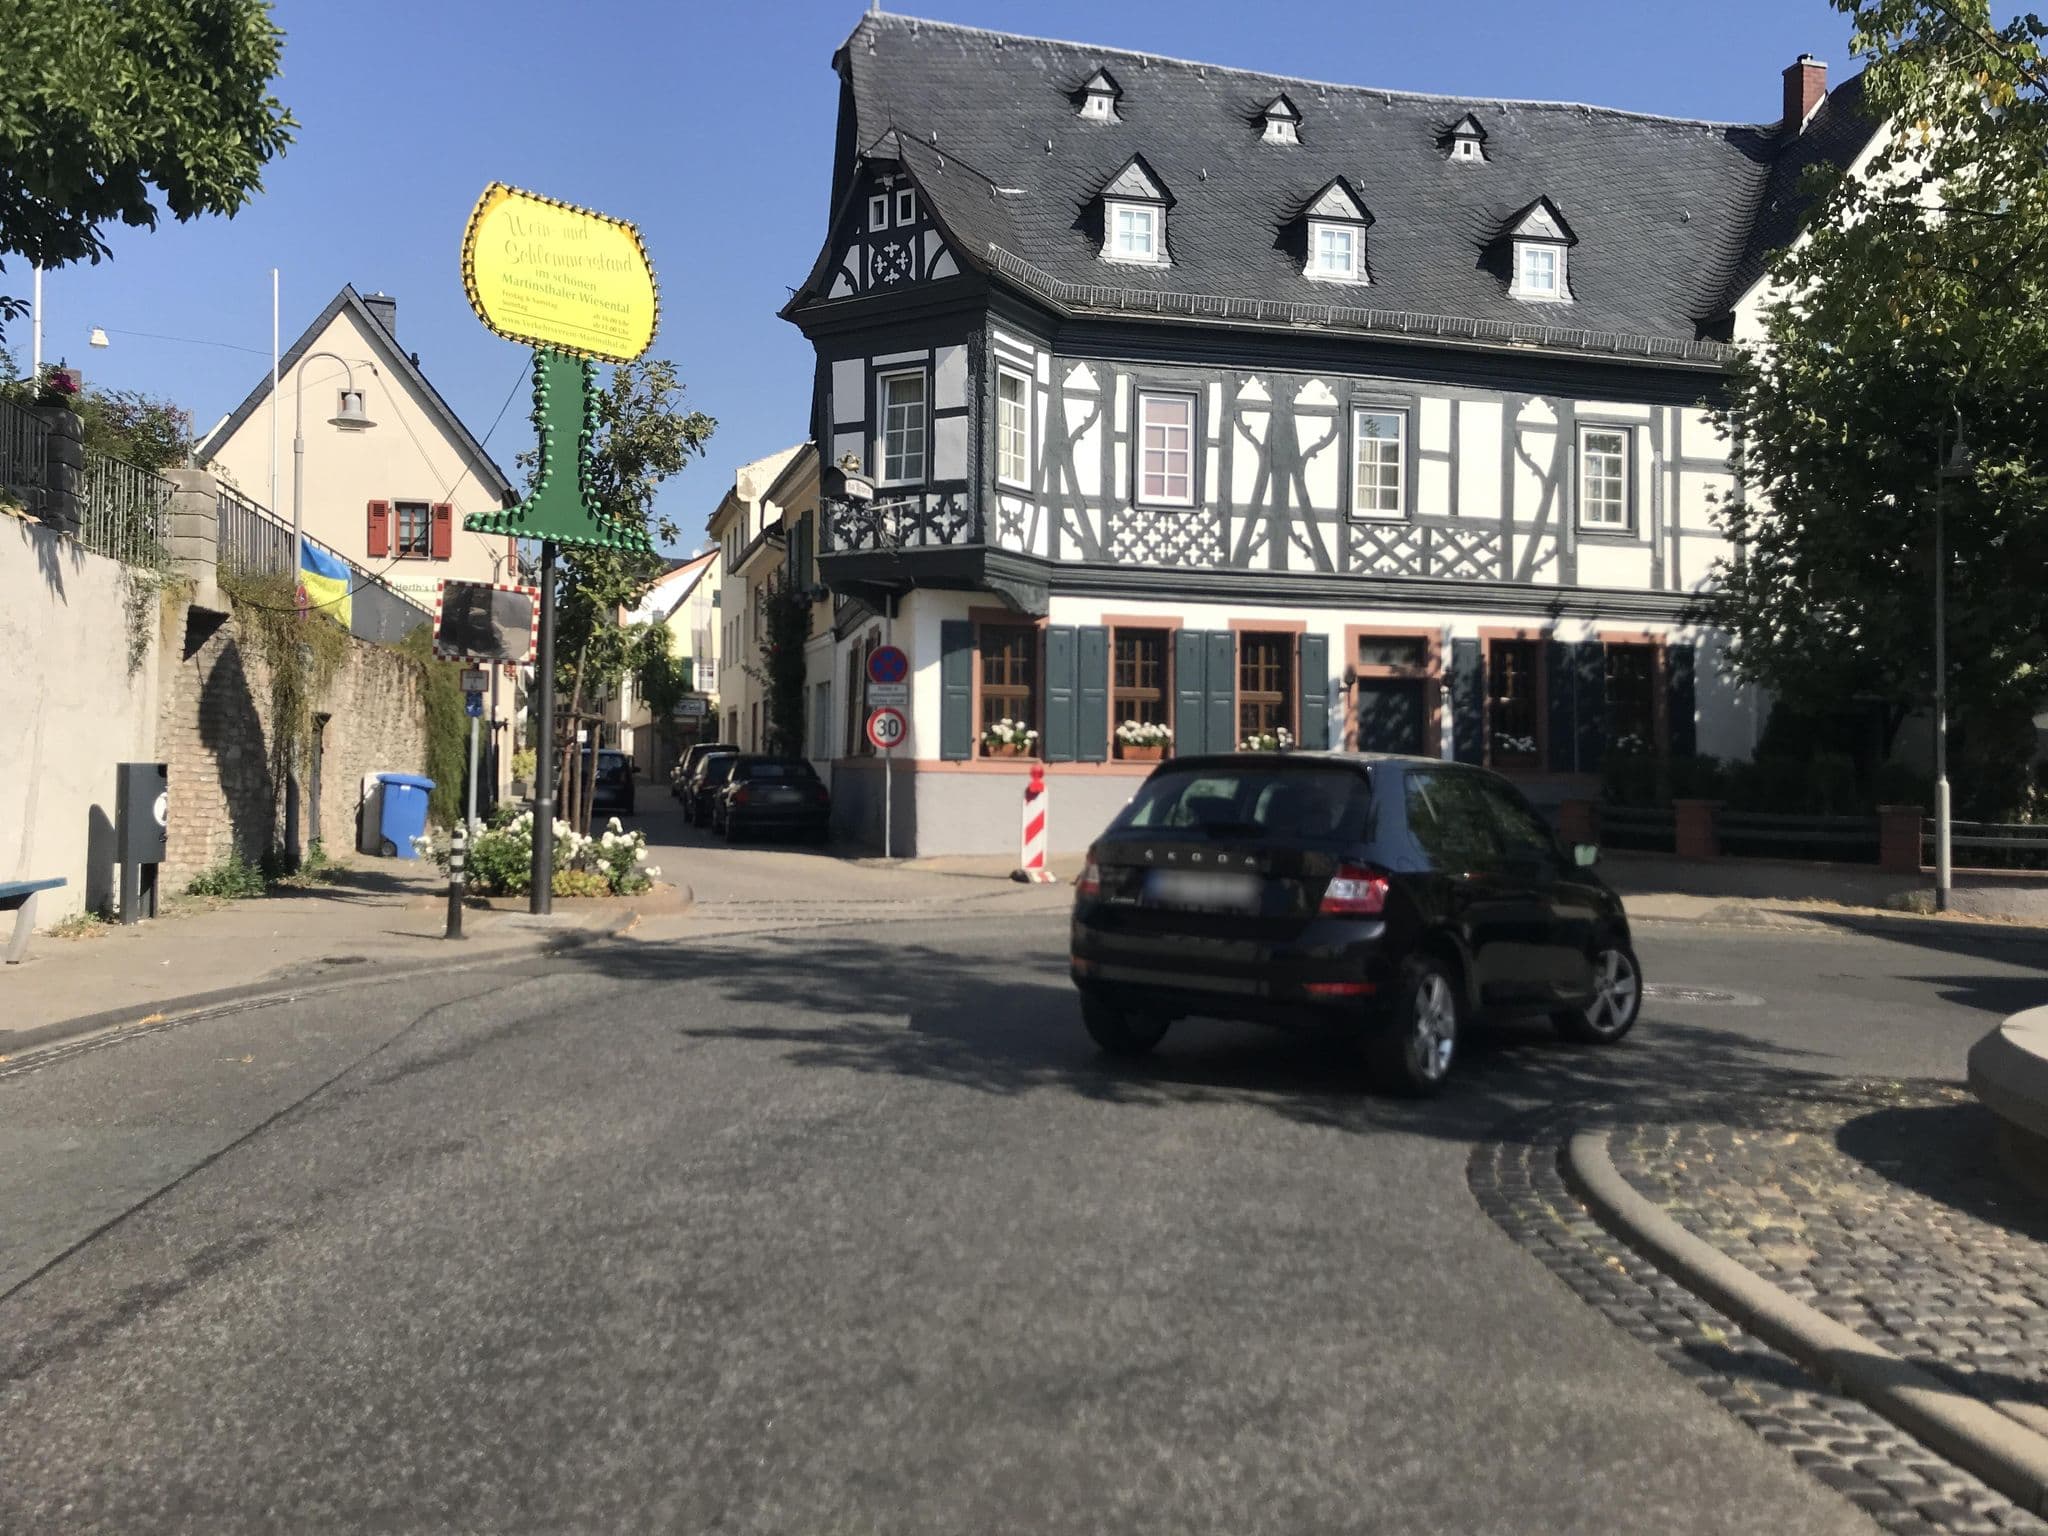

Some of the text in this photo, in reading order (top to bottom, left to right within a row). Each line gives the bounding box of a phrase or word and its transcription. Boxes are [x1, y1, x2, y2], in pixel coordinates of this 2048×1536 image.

[502, 272, 630, 314] Martinsthaler Wiesental
[877, 719, 899, 737] 30
